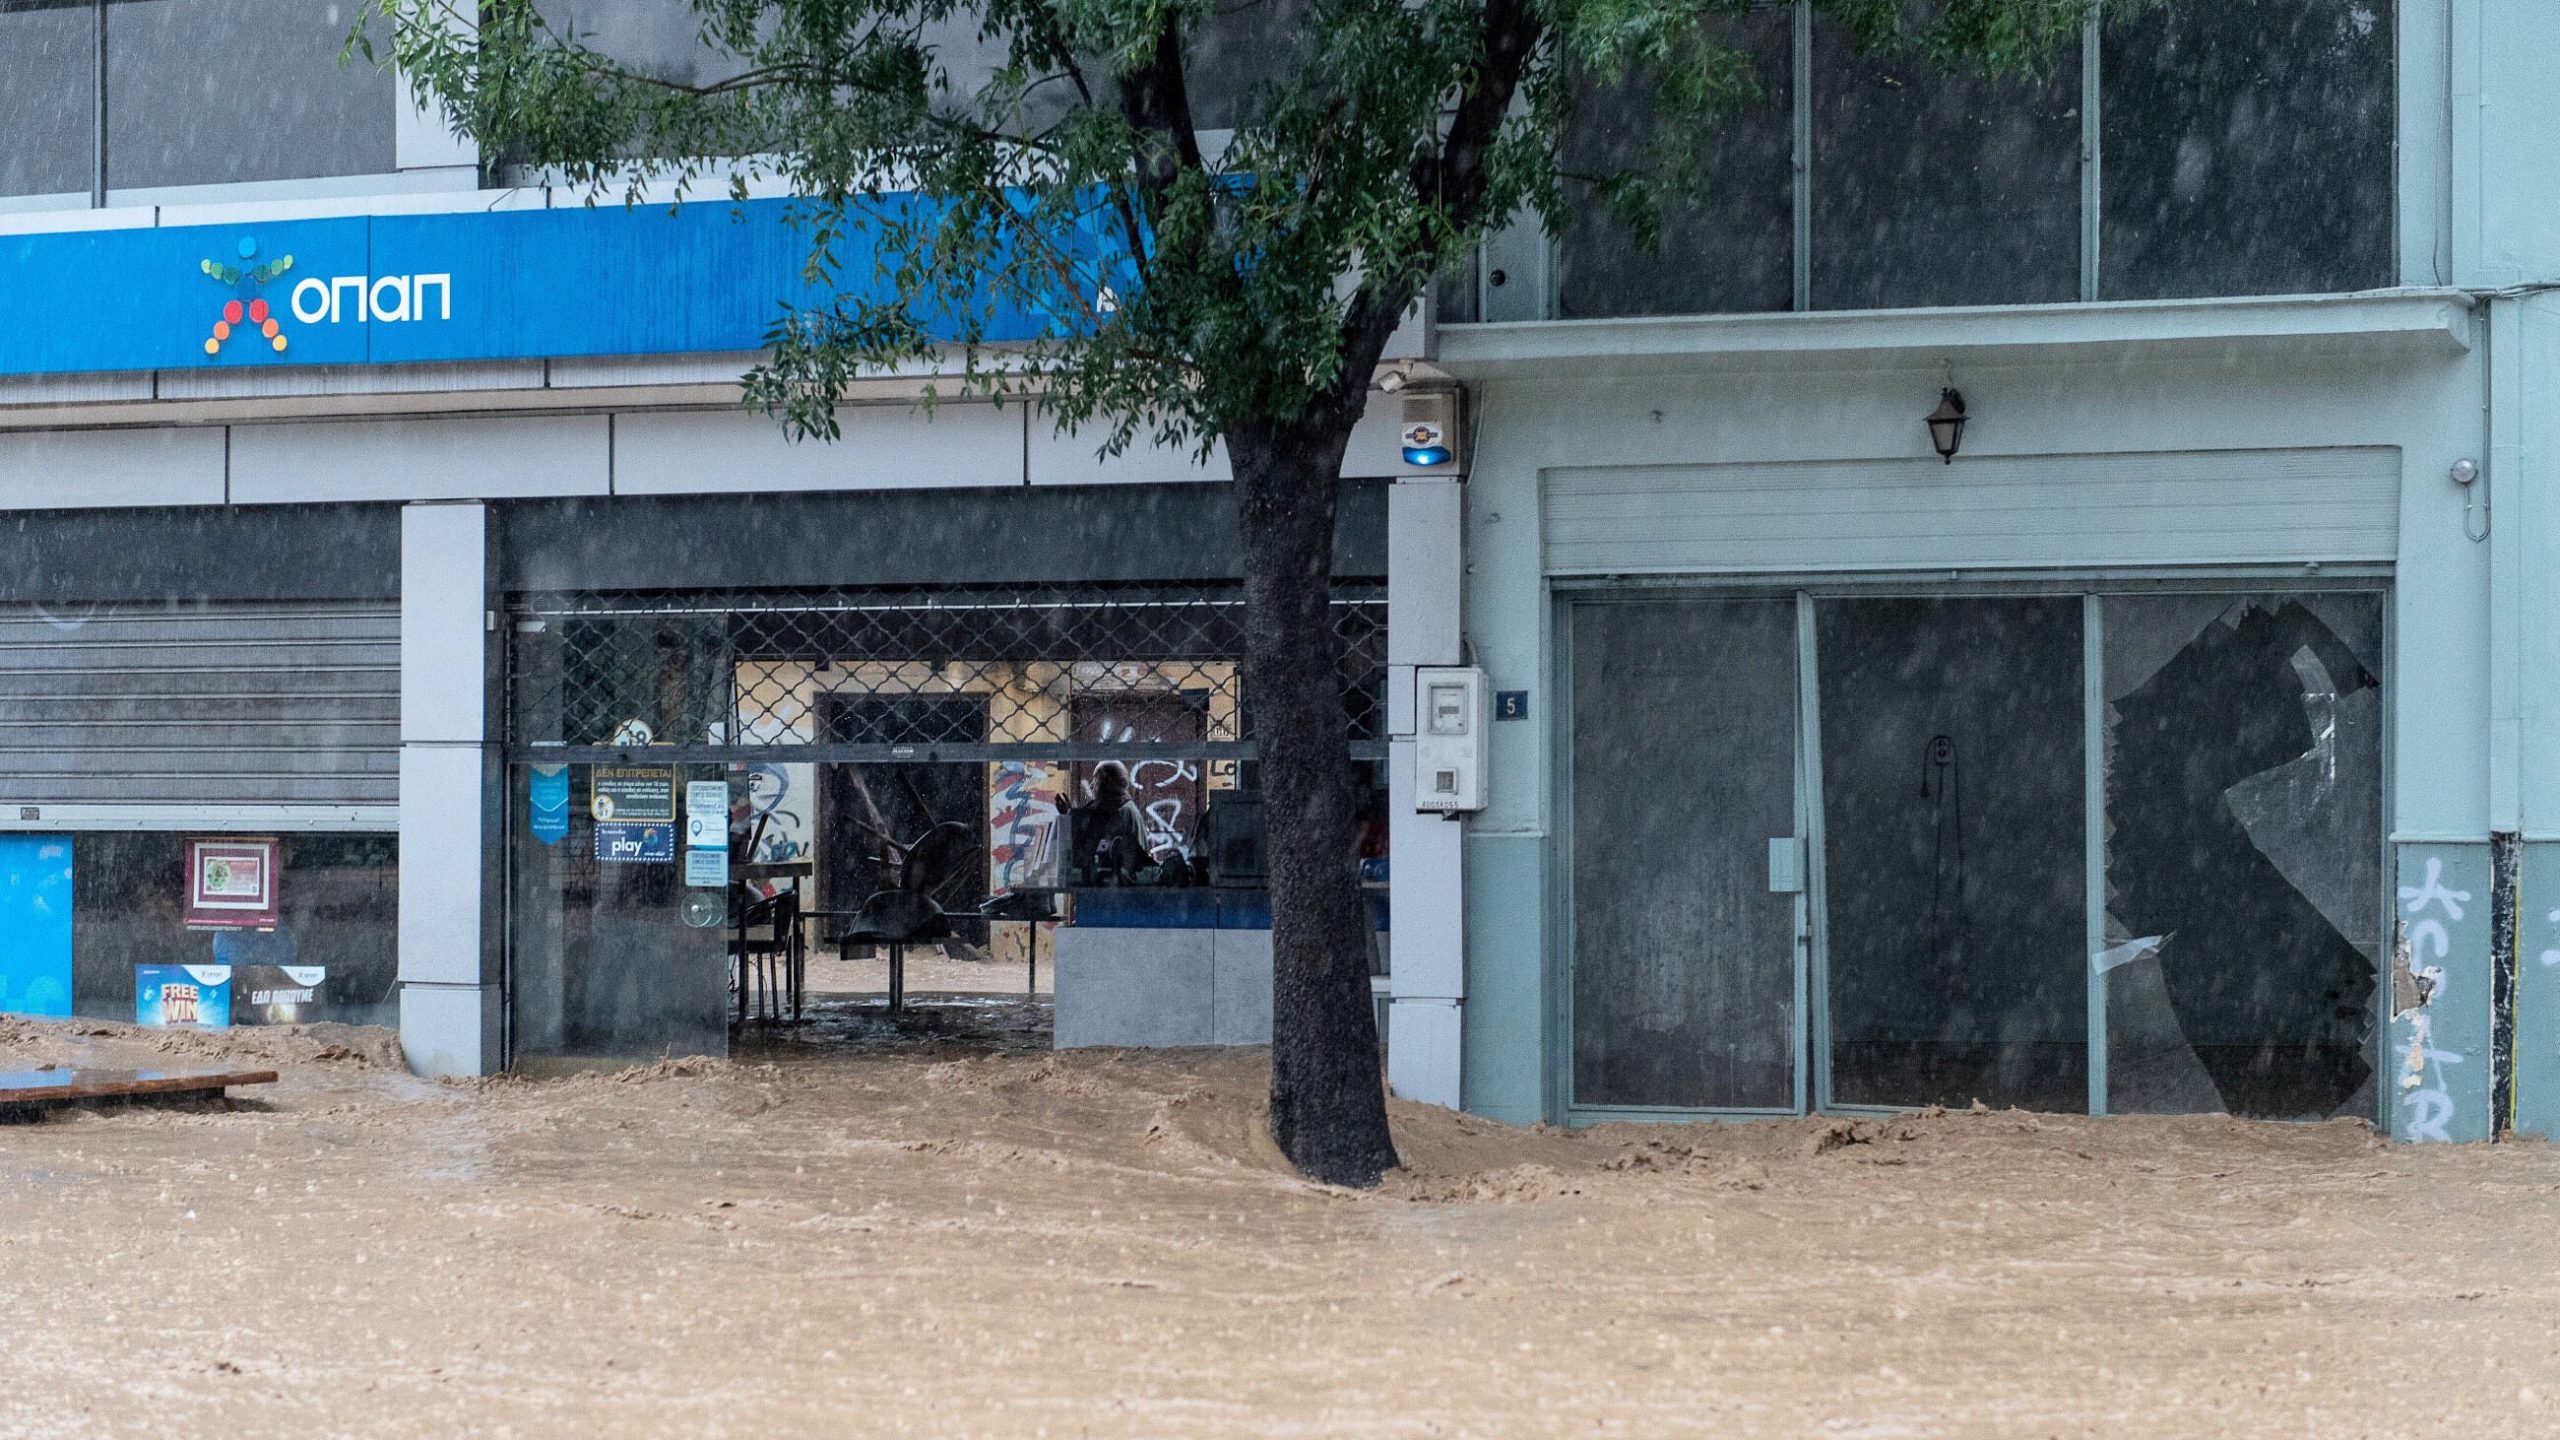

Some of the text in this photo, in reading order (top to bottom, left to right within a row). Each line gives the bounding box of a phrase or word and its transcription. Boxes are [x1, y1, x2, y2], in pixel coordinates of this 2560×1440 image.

[1506, 697, 1516, 714] 5
[595, 768, 614, 778] ΔΕΝ
[611, 836, 643, 857] play
[160, 983, 199, 1000] FREE
[162, 999, 199, 1023] WIN
